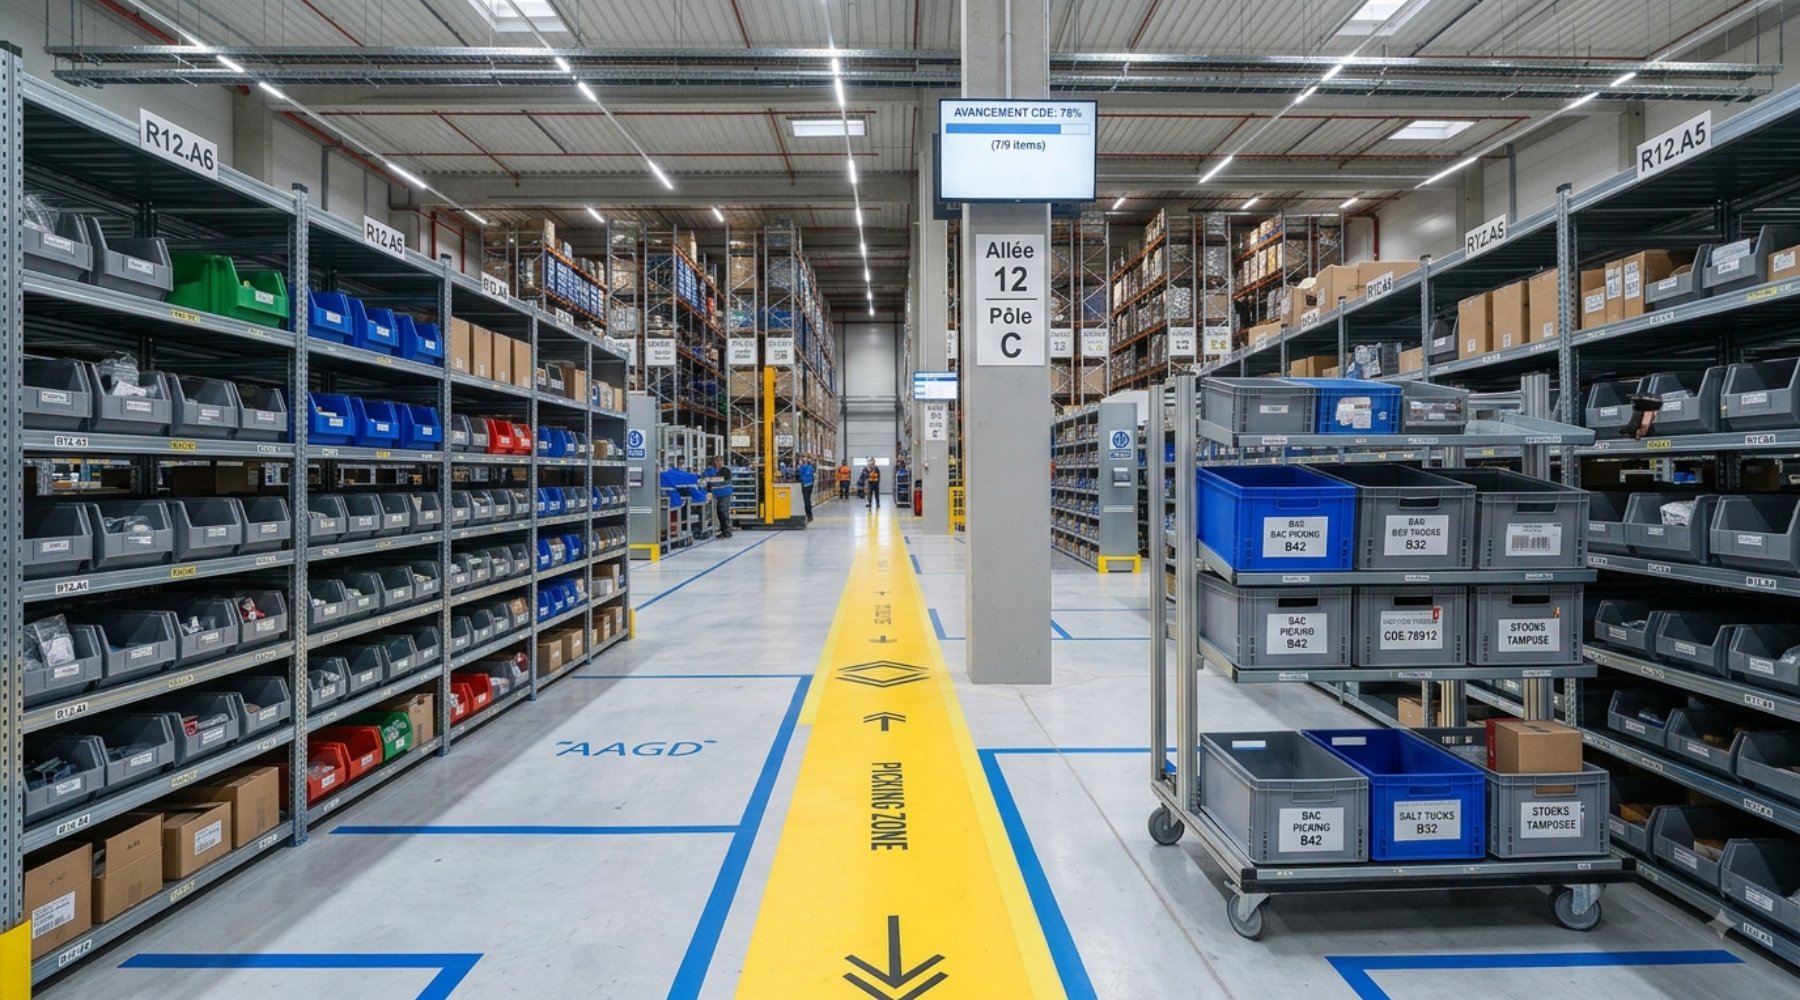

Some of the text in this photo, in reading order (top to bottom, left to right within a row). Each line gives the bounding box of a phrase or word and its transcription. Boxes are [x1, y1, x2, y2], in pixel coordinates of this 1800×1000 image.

[954, 107, 1082, 118] AVANCEMENT CDE: 78%
[145, 119, 214, 171] R12.A6
[991, 139, 1046, 151] (7/9 items)
[1641, 120, 1706, 172] R12.A5
[985, 240, 1034, 259] Allée
[994, 266, 1028, 292] 12
[989, 307, 1032, 324] Pôle
[1000, 331, 1022, 359] C
[1285, 541, 1307, 552] B42
[1407, 630, 1437, 641] 78912
[871, 762, 908, 851] PICKING ZONE
[1300, 834, 1322, 846] B42
